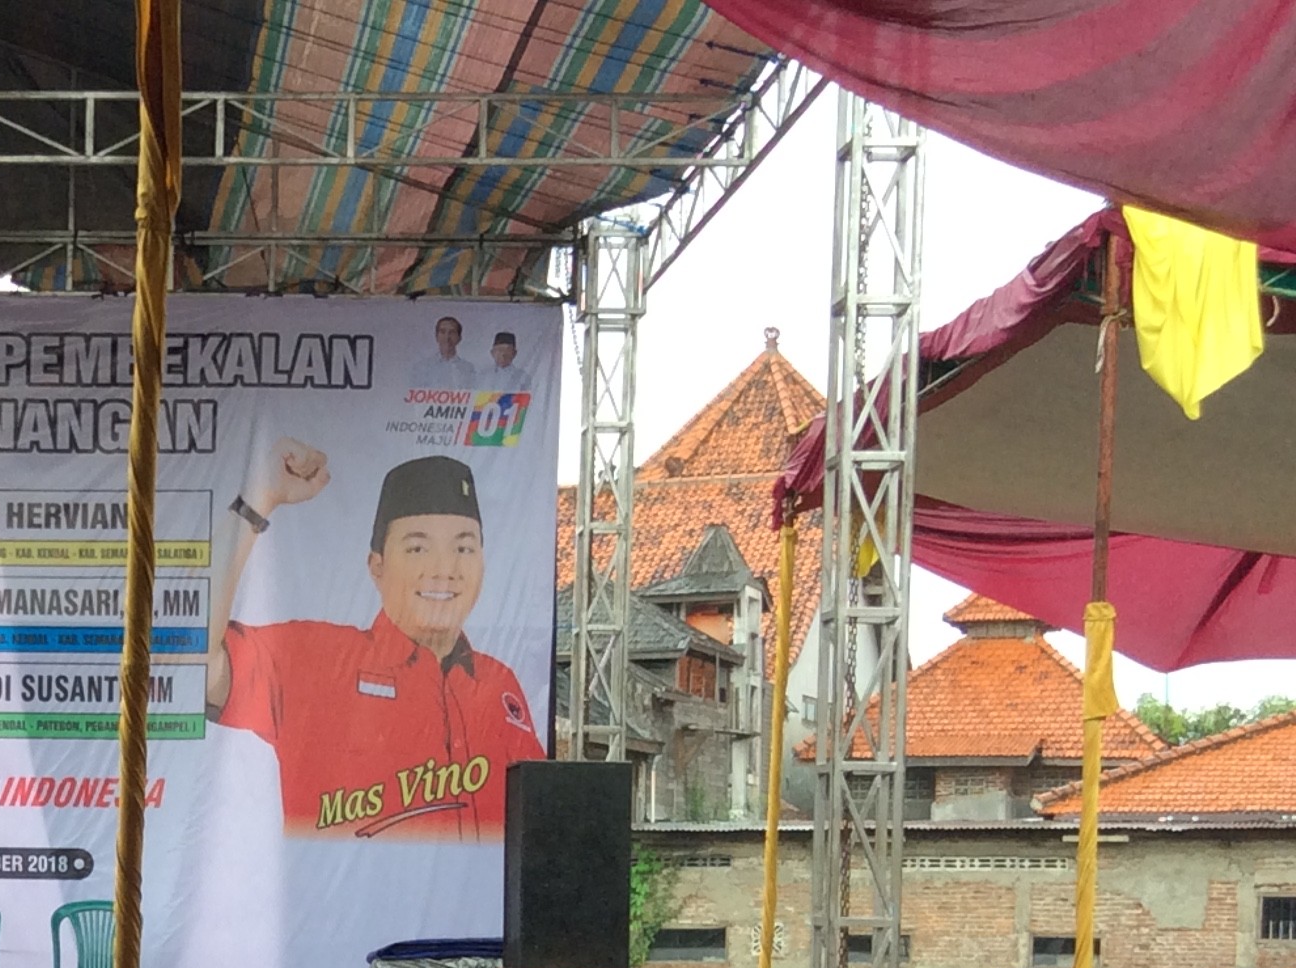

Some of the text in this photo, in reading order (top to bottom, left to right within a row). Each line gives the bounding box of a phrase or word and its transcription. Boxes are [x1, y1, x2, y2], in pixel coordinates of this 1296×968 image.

[404, 389, 471, 404] JOKOWI
[423, 404, 468, 419] AMIN
[477, 401, 523, 437] 01
[385, 420, 455, 434] INDONESIA
[415, 433, 452, 446] MAJU
[6, 501, 129, 530] HERVIAN
[21, 674, 119, 703] SUSANT
[316, 756, 490, 829] Mas Vino
[27, 855, 69, 872] 2018
